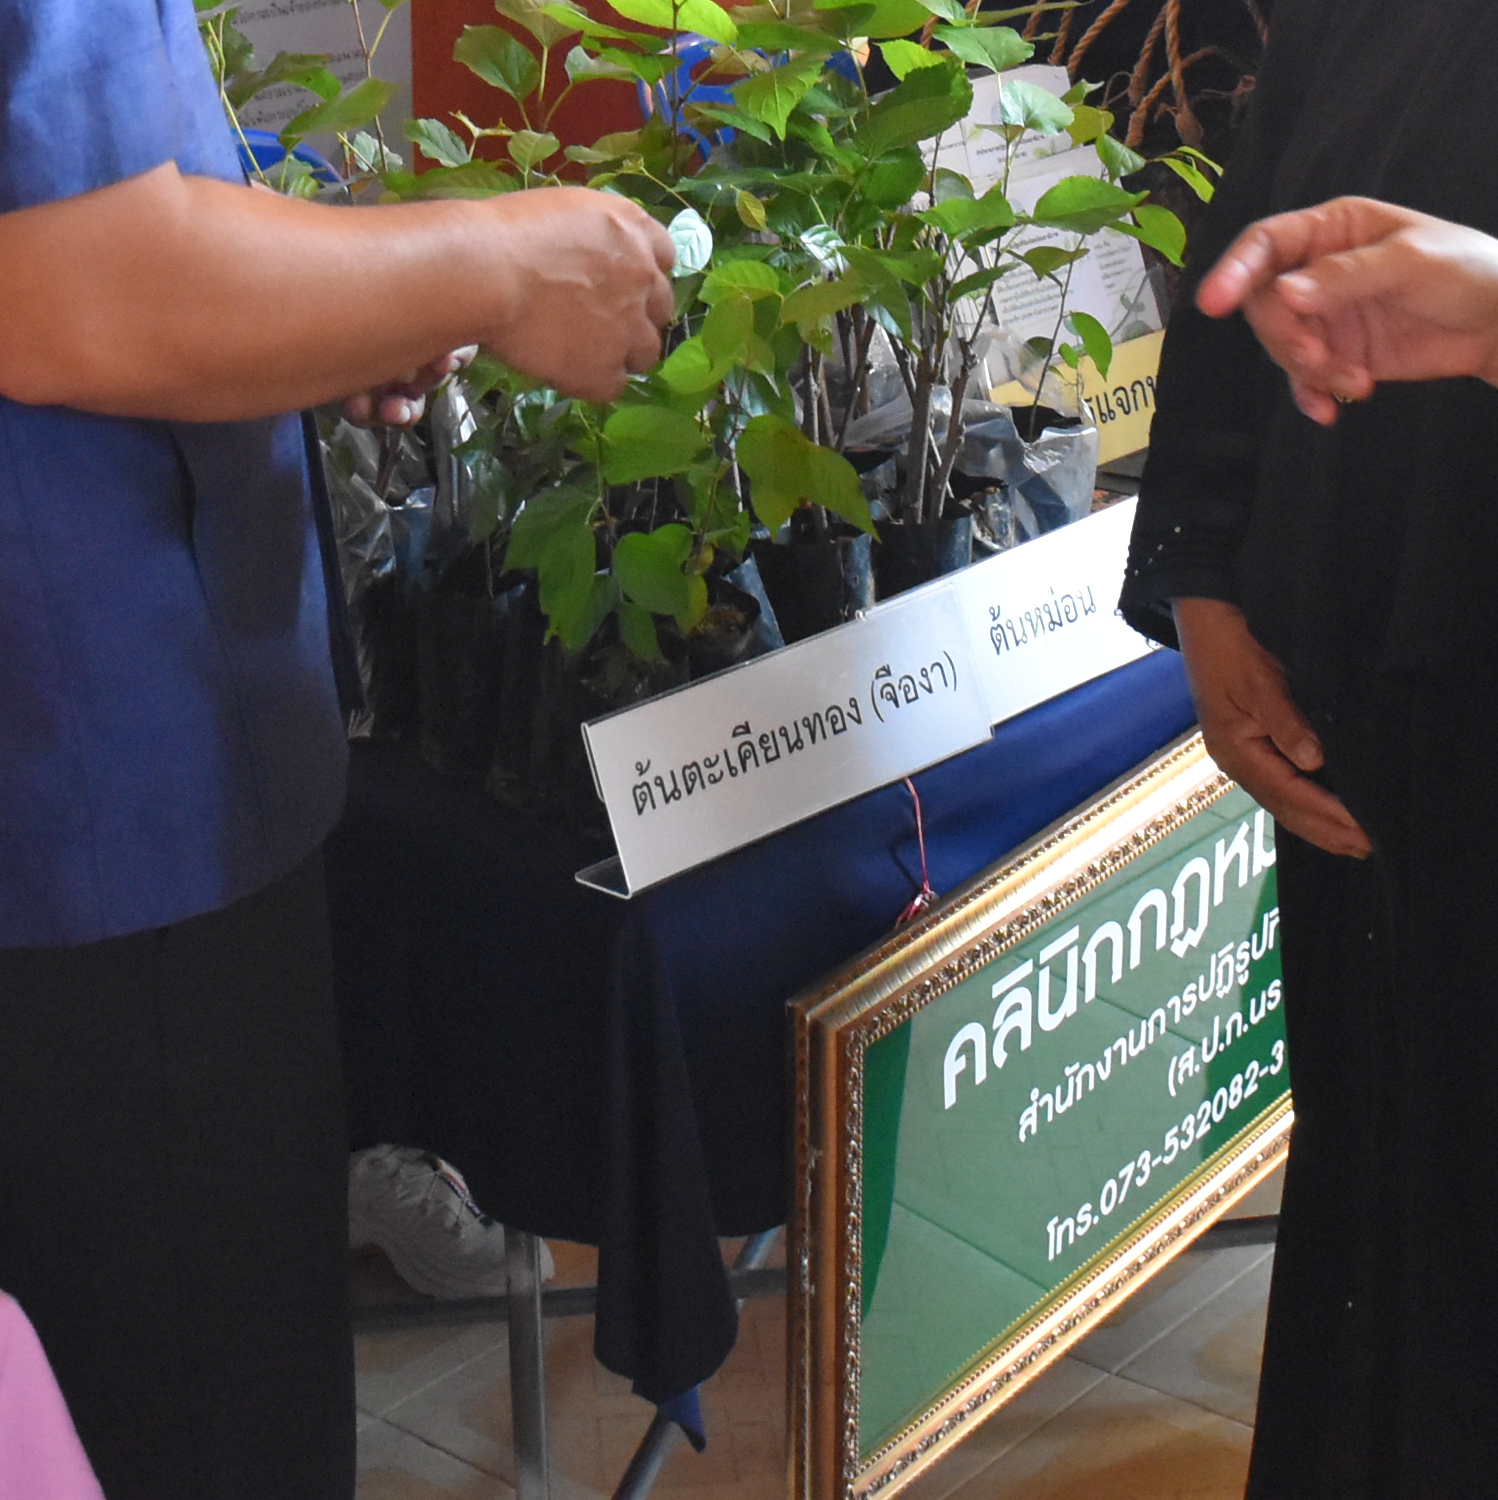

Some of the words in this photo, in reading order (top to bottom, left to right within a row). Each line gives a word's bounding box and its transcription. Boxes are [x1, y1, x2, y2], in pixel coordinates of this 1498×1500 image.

[989, 584, 1097, 656] ต้นหม่อน
[632, 700, 864, 817] ต้นตะเคียนทอง
